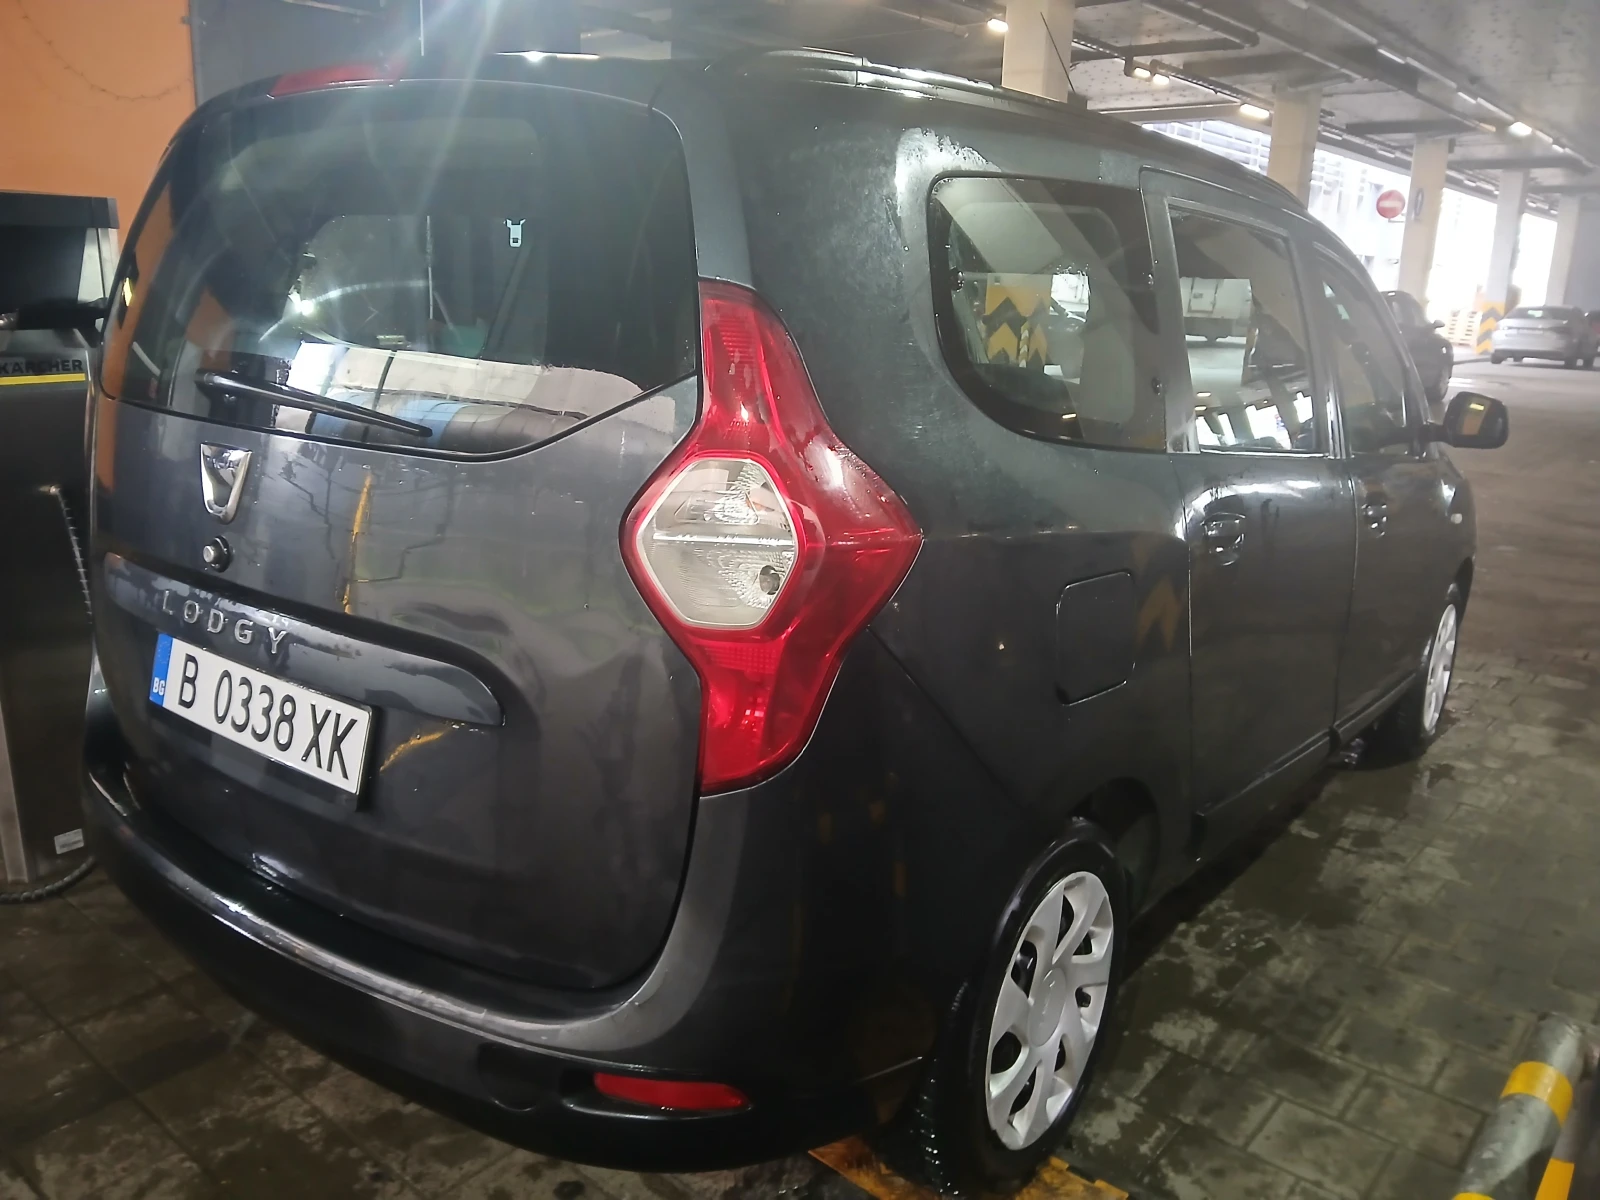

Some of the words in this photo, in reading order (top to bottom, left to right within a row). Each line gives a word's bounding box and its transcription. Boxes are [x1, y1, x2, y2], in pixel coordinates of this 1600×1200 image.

[162, 590, 287, 654] LODGY
[152, 677, 166, 696] BG
[178, 653, 199, 709] B
[214, 669, 297, 752] 0338
[301, 702, 358, 780] XK
